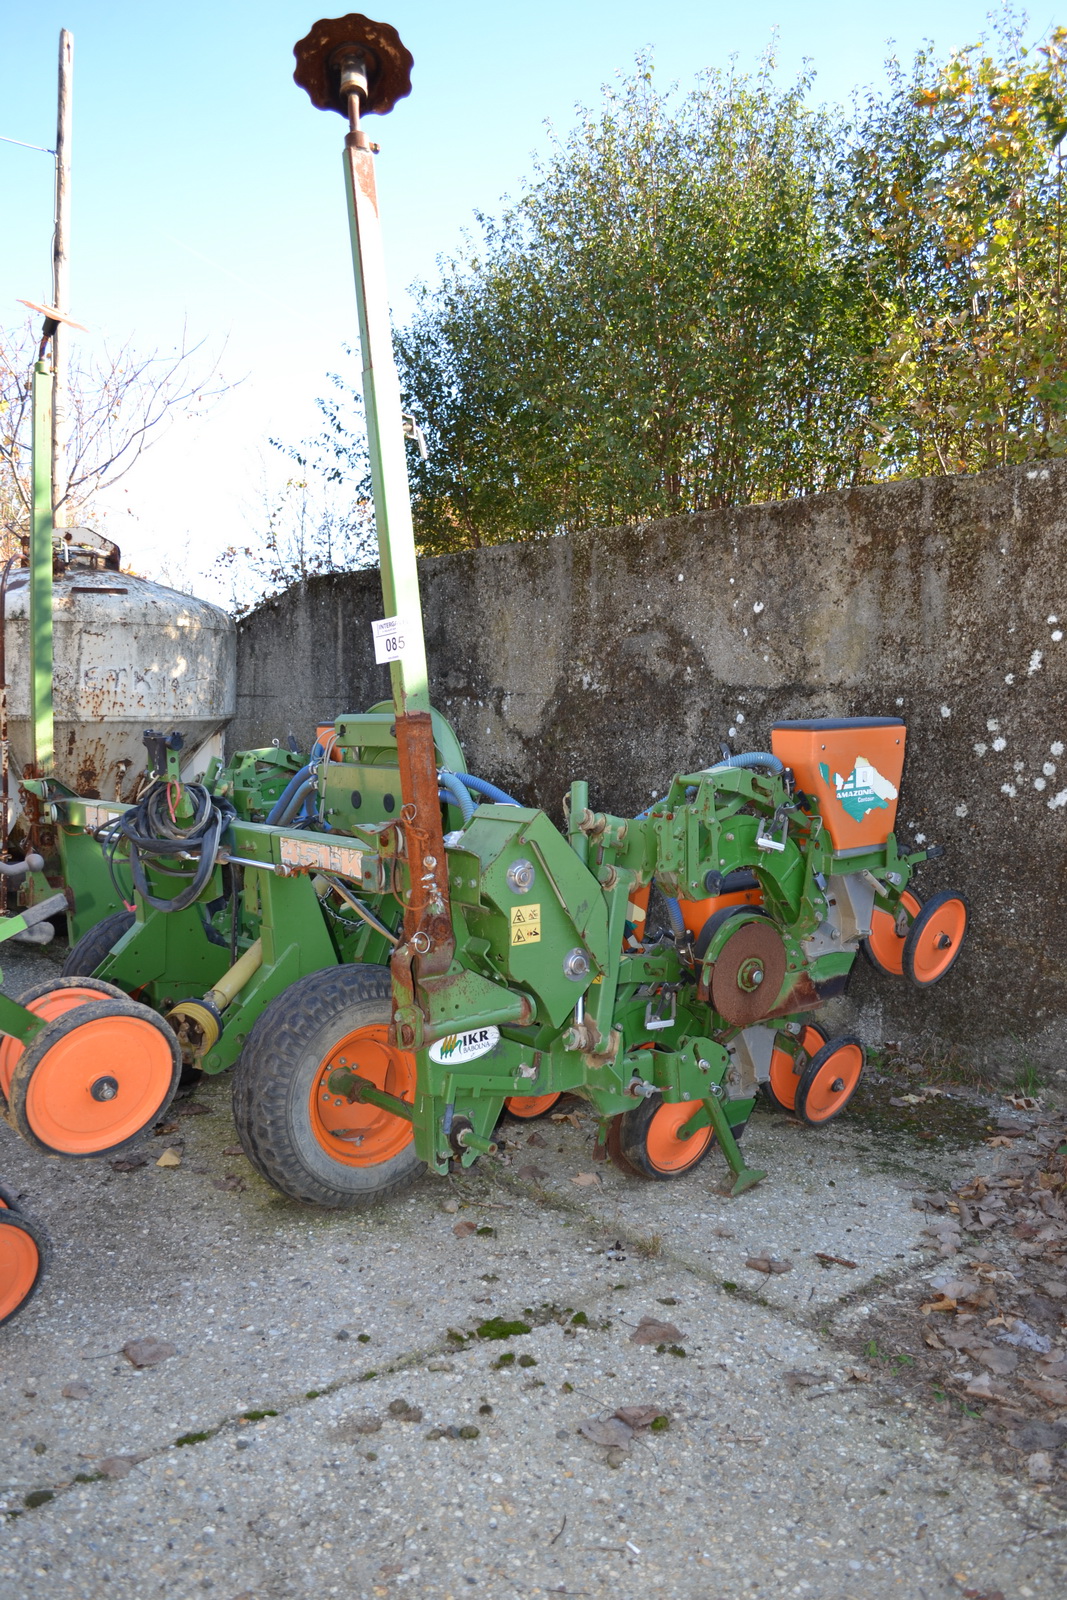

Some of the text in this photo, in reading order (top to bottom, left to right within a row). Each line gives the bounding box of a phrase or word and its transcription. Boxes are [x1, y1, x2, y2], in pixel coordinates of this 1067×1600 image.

[385, 636, 405, 652] 085
[836, 788, 874, 799] AMAZONE
[281, 840, 362, 879] 451-K
[463, 1030, 489, 1046] IKR
